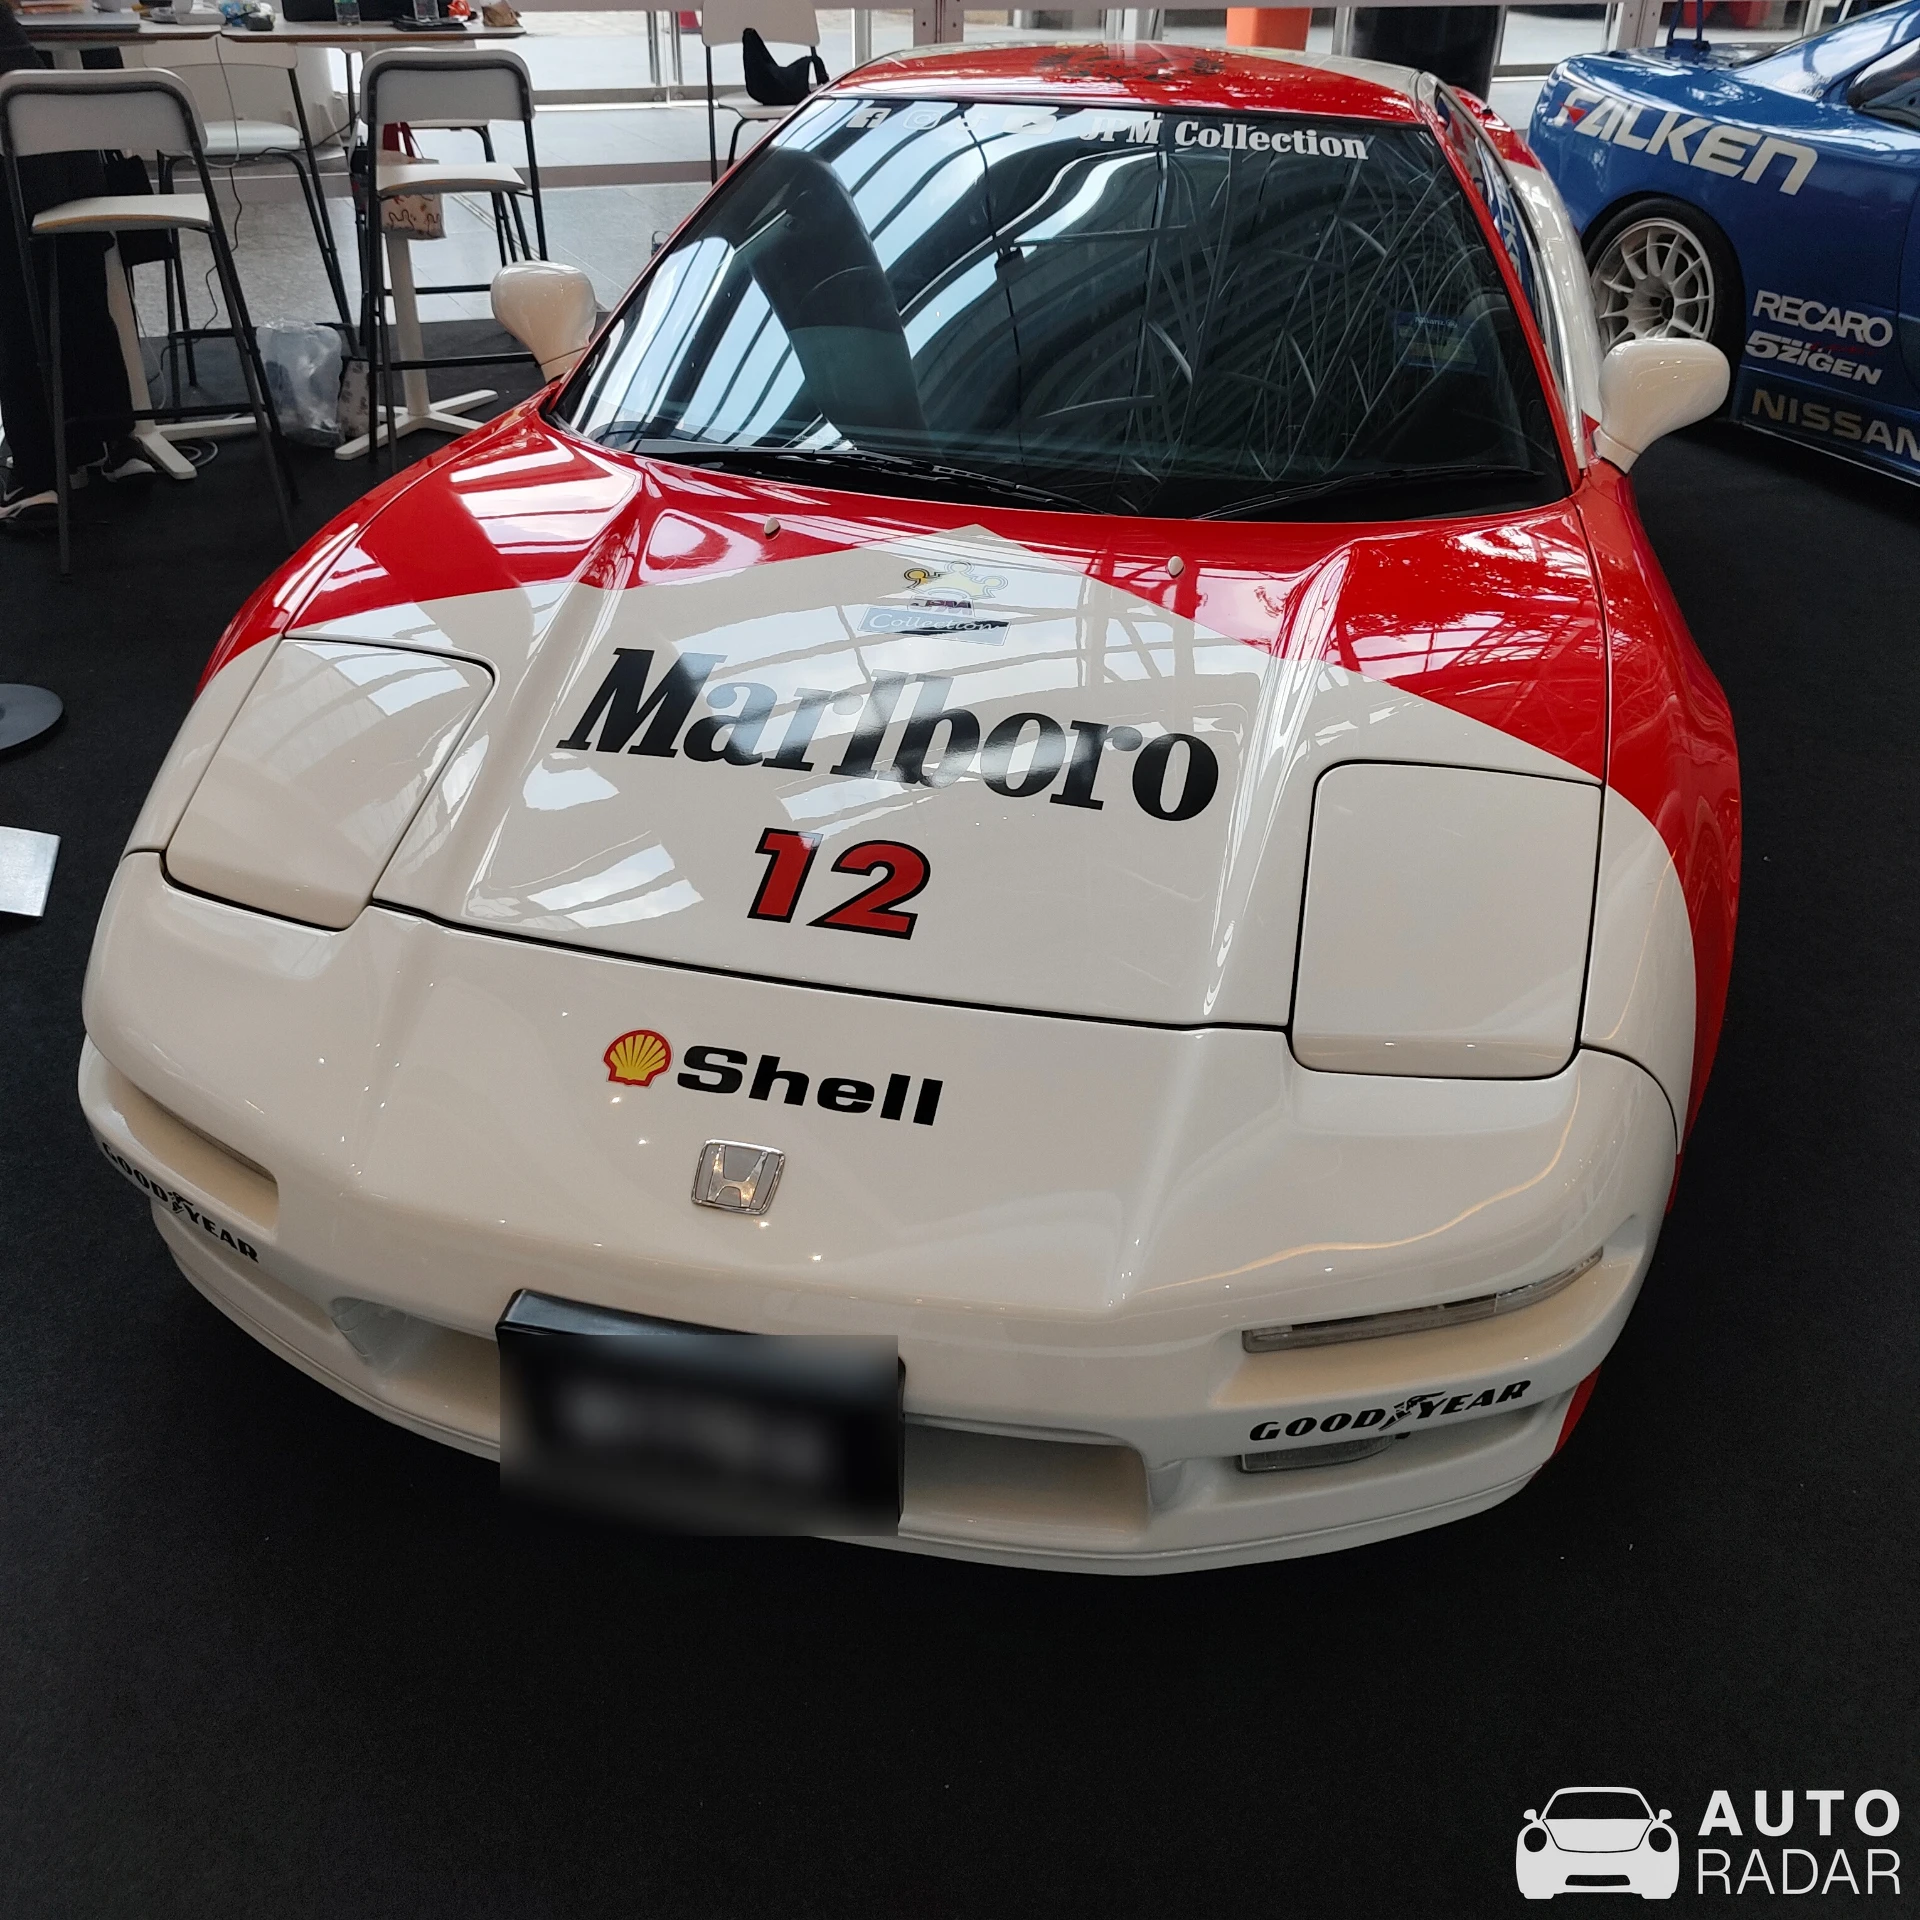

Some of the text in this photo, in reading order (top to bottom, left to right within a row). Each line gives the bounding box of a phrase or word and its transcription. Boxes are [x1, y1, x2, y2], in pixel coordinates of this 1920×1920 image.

[1079, 116, 1369, 160] JPM Collection
[1752, 290, 1893, 347] RECARO
[869, 613, 1001, 632] Collection
[556, 647, 1219, 822] Marlboro
[747, 827, 931, 941] 12
[677, 1045, 943, 1127] Shell
